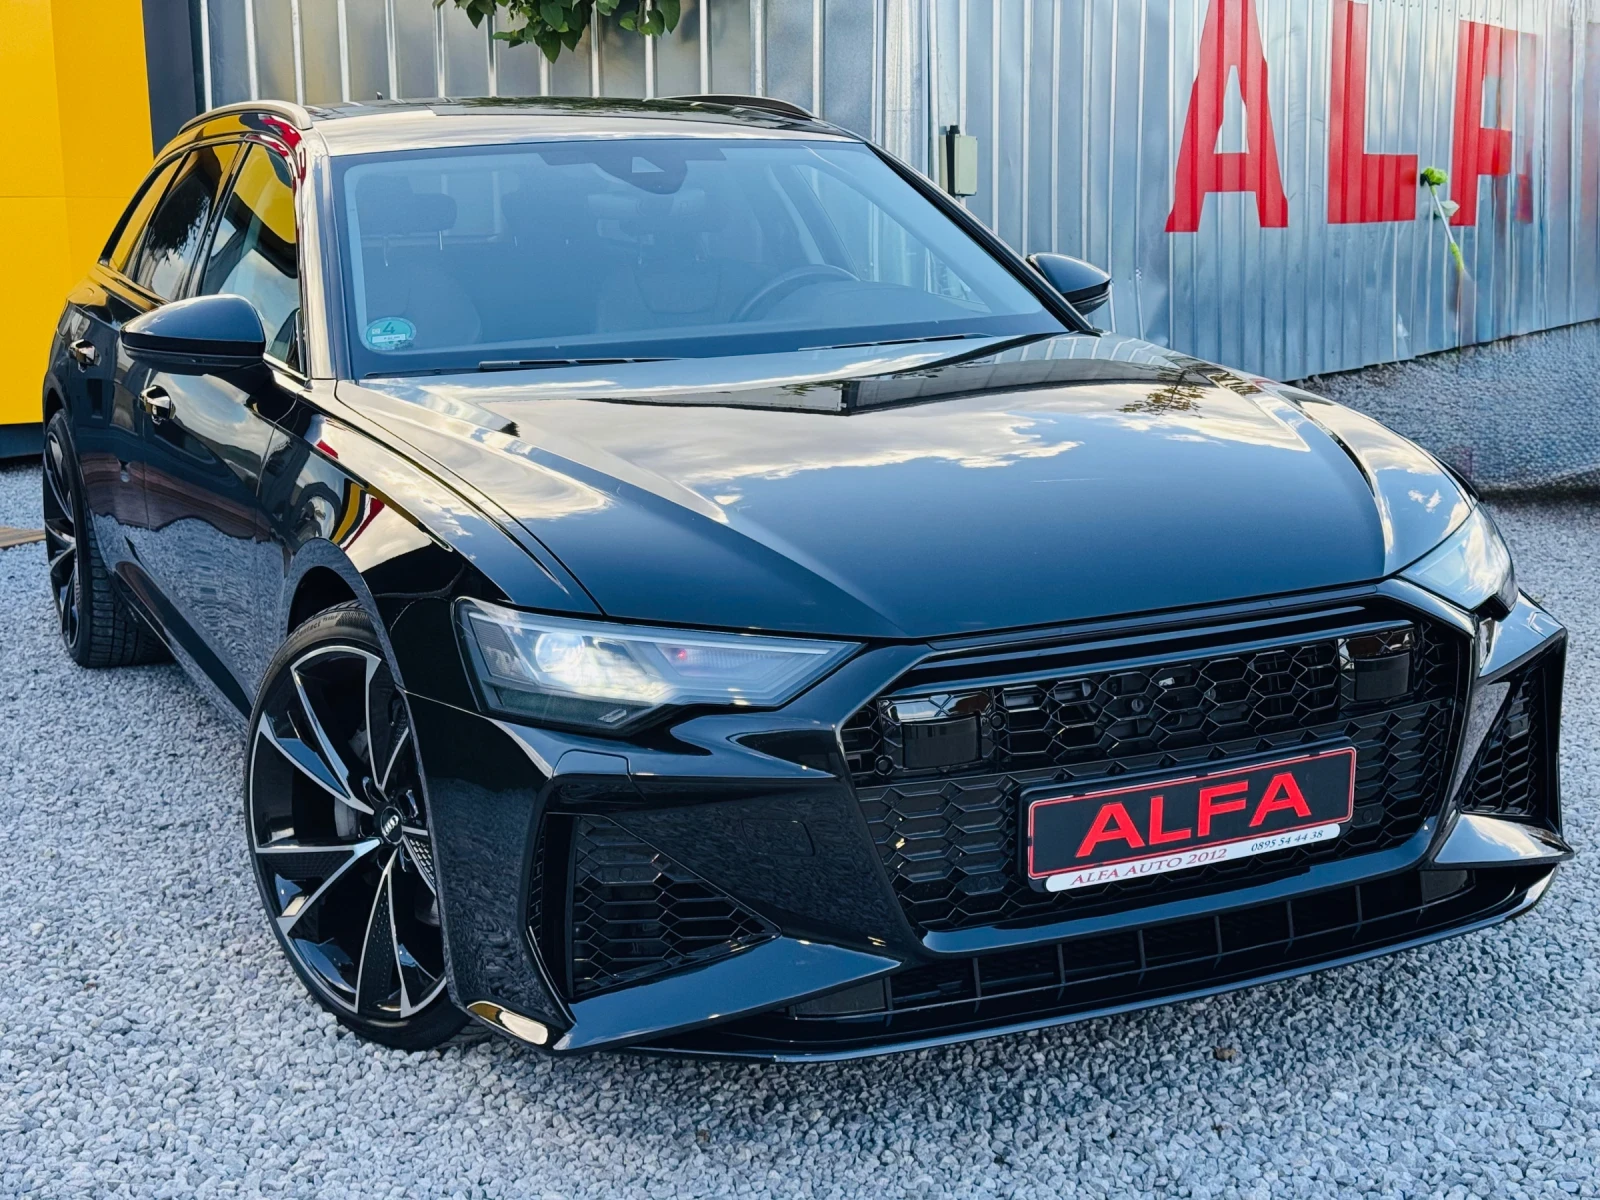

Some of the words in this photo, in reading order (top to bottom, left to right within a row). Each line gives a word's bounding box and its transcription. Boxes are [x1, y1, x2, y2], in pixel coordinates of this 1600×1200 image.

[382, 321, 396, 334] 4
[1075, 772, 1312, 858] ALFA
[1070, 868, 1119, 886] ALFA
[1124, 857, 1182, 876] AUTO
[1186, 848, 1228, 865] 2012
[1250, 839, 1277, 852] 0895
[1278, 836, 1292, 847] 54
[1294, 833, 1308, 843] 44
[1310, 829, 1324, 840] 38
